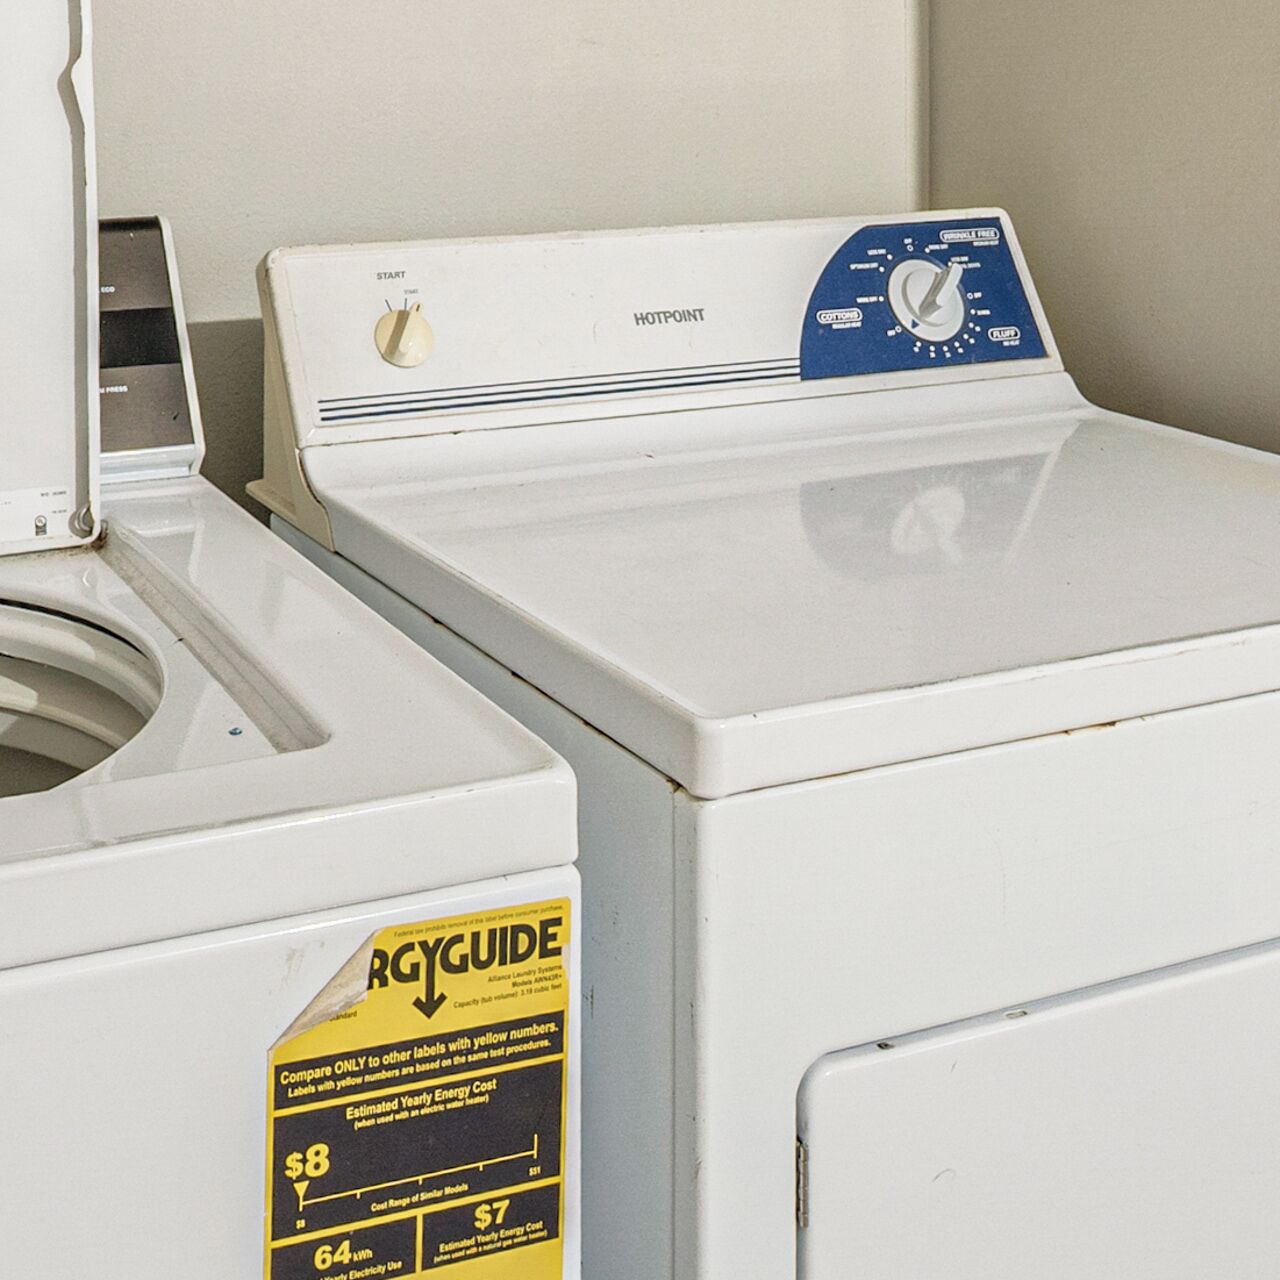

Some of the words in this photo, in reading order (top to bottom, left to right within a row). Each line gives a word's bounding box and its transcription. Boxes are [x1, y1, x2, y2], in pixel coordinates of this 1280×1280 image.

[376, 270, 406, 280] START
[633, 308, 704, 326] HOTPOINT
[821, 311, 859, 320] COTTONS
[992, 330, 1016, 339] FLUFF
[367, 916, 563, 992] RGYGUIDE
[488, 974, 511, 983] Alliance
[513, 969, 536, 979] Laundry
[453, 999, 479, 1008] Capacity
[280, 1065, 332, 1084] Compare
[334, 1056, 367, 1074] ONLY
[368, 1056, 380, 1068] to
[382, 1051, 412, 1065] other
[413, 1043, 446, 1059] labels
[448, 1037, 471, 1052] with
[473, 1031, 508, 1050] yellow
[509, 1022, 559, 1040] numbers.
[288, 1084, 316, 1098] Labels
[317, 1080, 335, 1092] with
[336, 1076, 363, 1090] yellow
[364, 1068, 399, 1083] numbers
[401, 1065, 414, 1074] are
[416, 1059, 440, 1073] based
[441, 1058, 452, 1067] on
[453, 1055, 466, 1064] the
[467, 1051, 488, 1063] same
[490, 1047, 505, 1058] test
[506, 1039, 551, 1056] procedures.
[346, 1098, 399, 1120] Estimated
[401, 1092, 432, 1108] Yearly
[434, 1085, 471, 1102] Energy
[472, 1078, 497, 1093] Cost
[354, 1118, 375, 1130] (when
[376, 1114, 394, 1124] used
[395, 1110, 409, 1120] with
[410, 1109, 420, 1117] an
[420, 1103, 445, 1115] electric
[446, 1100, 464, 1109] water
[465, 1094, 489, 1105] heater)
[284, 1142, 330, 1180] $8
[370, 1200, 388, 1212] Cost
[388, 1196, 410, 1208] Range
[411, 1194, 419, 1203] of
[420, 1189, 443, 1201] Similar
[444, 1182, 469, 1195] Models
[474, 1199, 510, 1231] $7
[439, 1236, 476, 1253] Estimated
[477, 1232, 499, 1244] Yearly
[499, 1225, 524, 1239] Energy
[526, 1221, 543, 1232] Cost
[451, 1250, 465, 1259] used
[466, 1246, 478, 1255] with
[483, 1241, 501, 1251] natural
[502, 1240, 513, 1248] gas
[514, 1235, 528, 1244] water
[314, 1239, 352, 1271] 64
[353, 1248, 374, 1262] kWh
[349, 1265, 386, 1280] Electricity
[387, 1260, 403, 1271] Use
